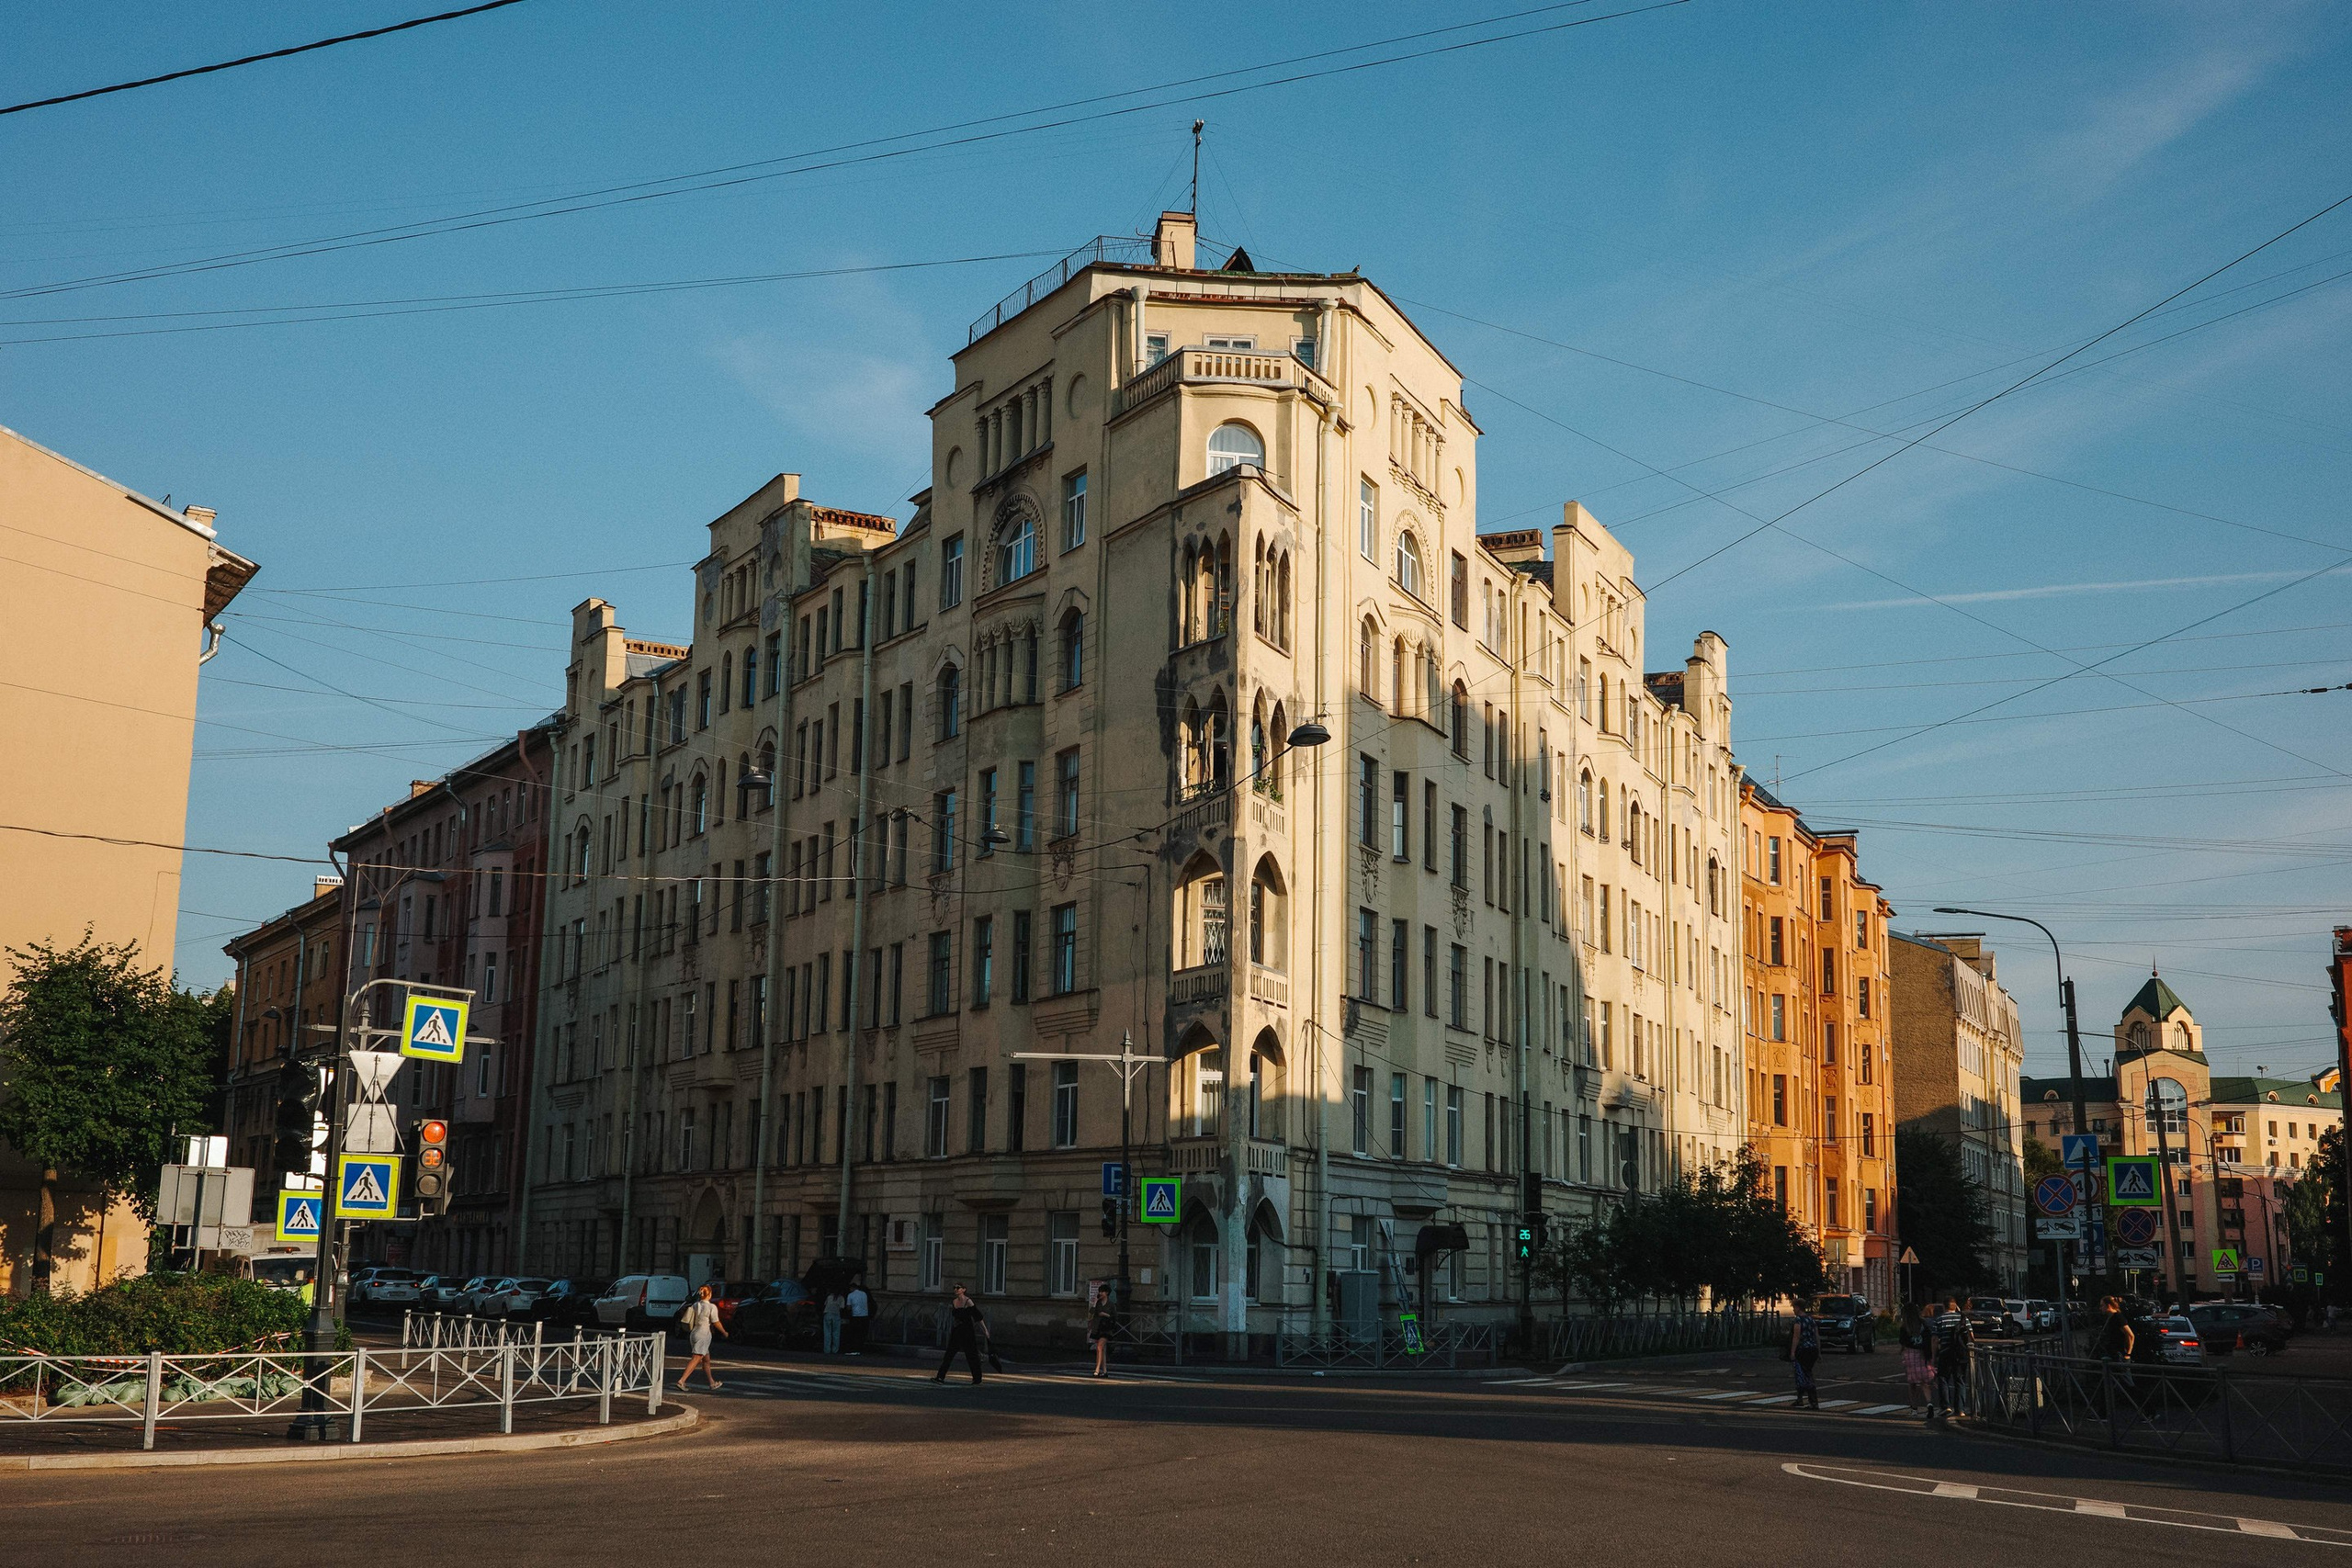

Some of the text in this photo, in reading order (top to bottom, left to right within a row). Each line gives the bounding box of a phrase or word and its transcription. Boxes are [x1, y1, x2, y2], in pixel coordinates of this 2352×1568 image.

[424, 1151, 441, 1166] 32
[1520, 1229, 1531, 1240] 26
[2252, 1258, 2260, 1270] P
